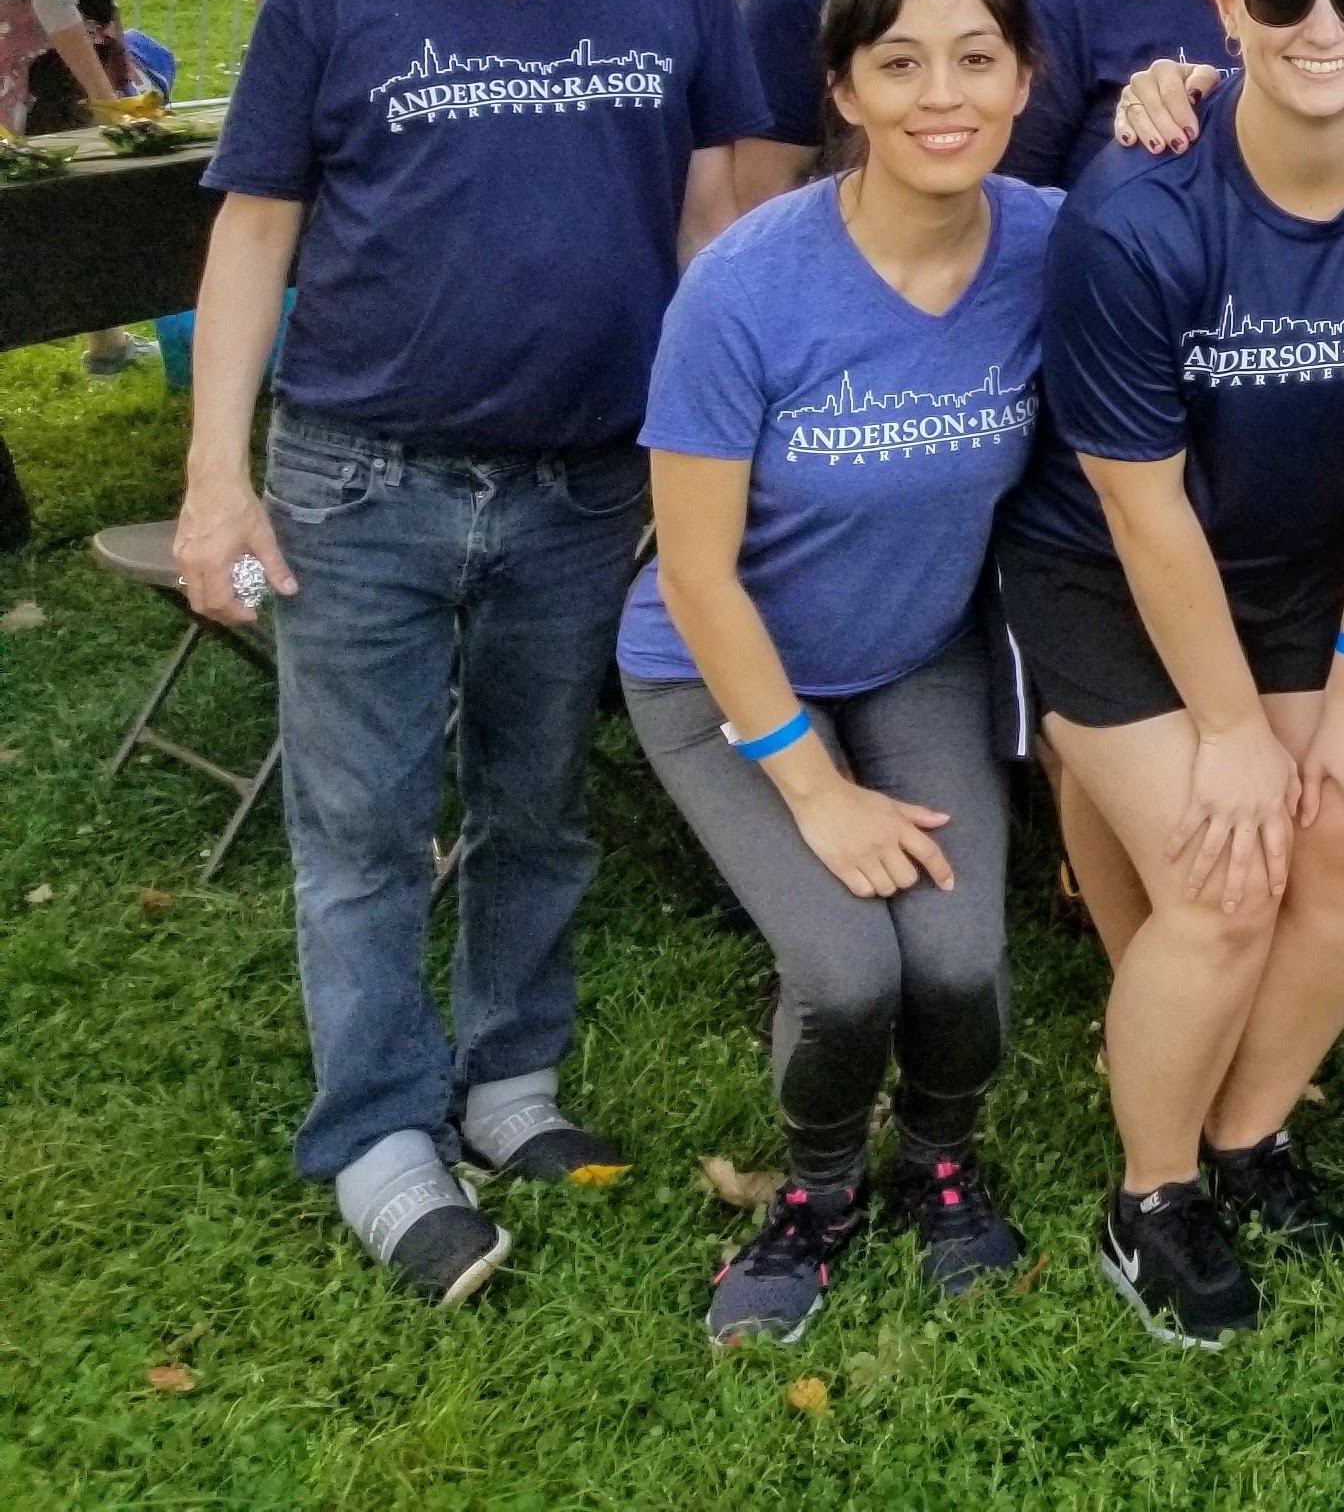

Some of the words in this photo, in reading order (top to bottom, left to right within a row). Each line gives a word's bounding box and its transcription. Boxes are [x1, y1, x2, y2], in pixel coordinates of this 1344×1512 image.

[386, 79, 550, 119] ANDERSON
[563, 73, 663, 98] RASOR
[428, 100, 586, 123] PARTNERS
[613, 97, 662, 108] LLP
[788, 412, 966, 449] ANDERSON
[979, 396, 1040, 430] RASO
[829, 433, 1001, 465] PARTNERS
